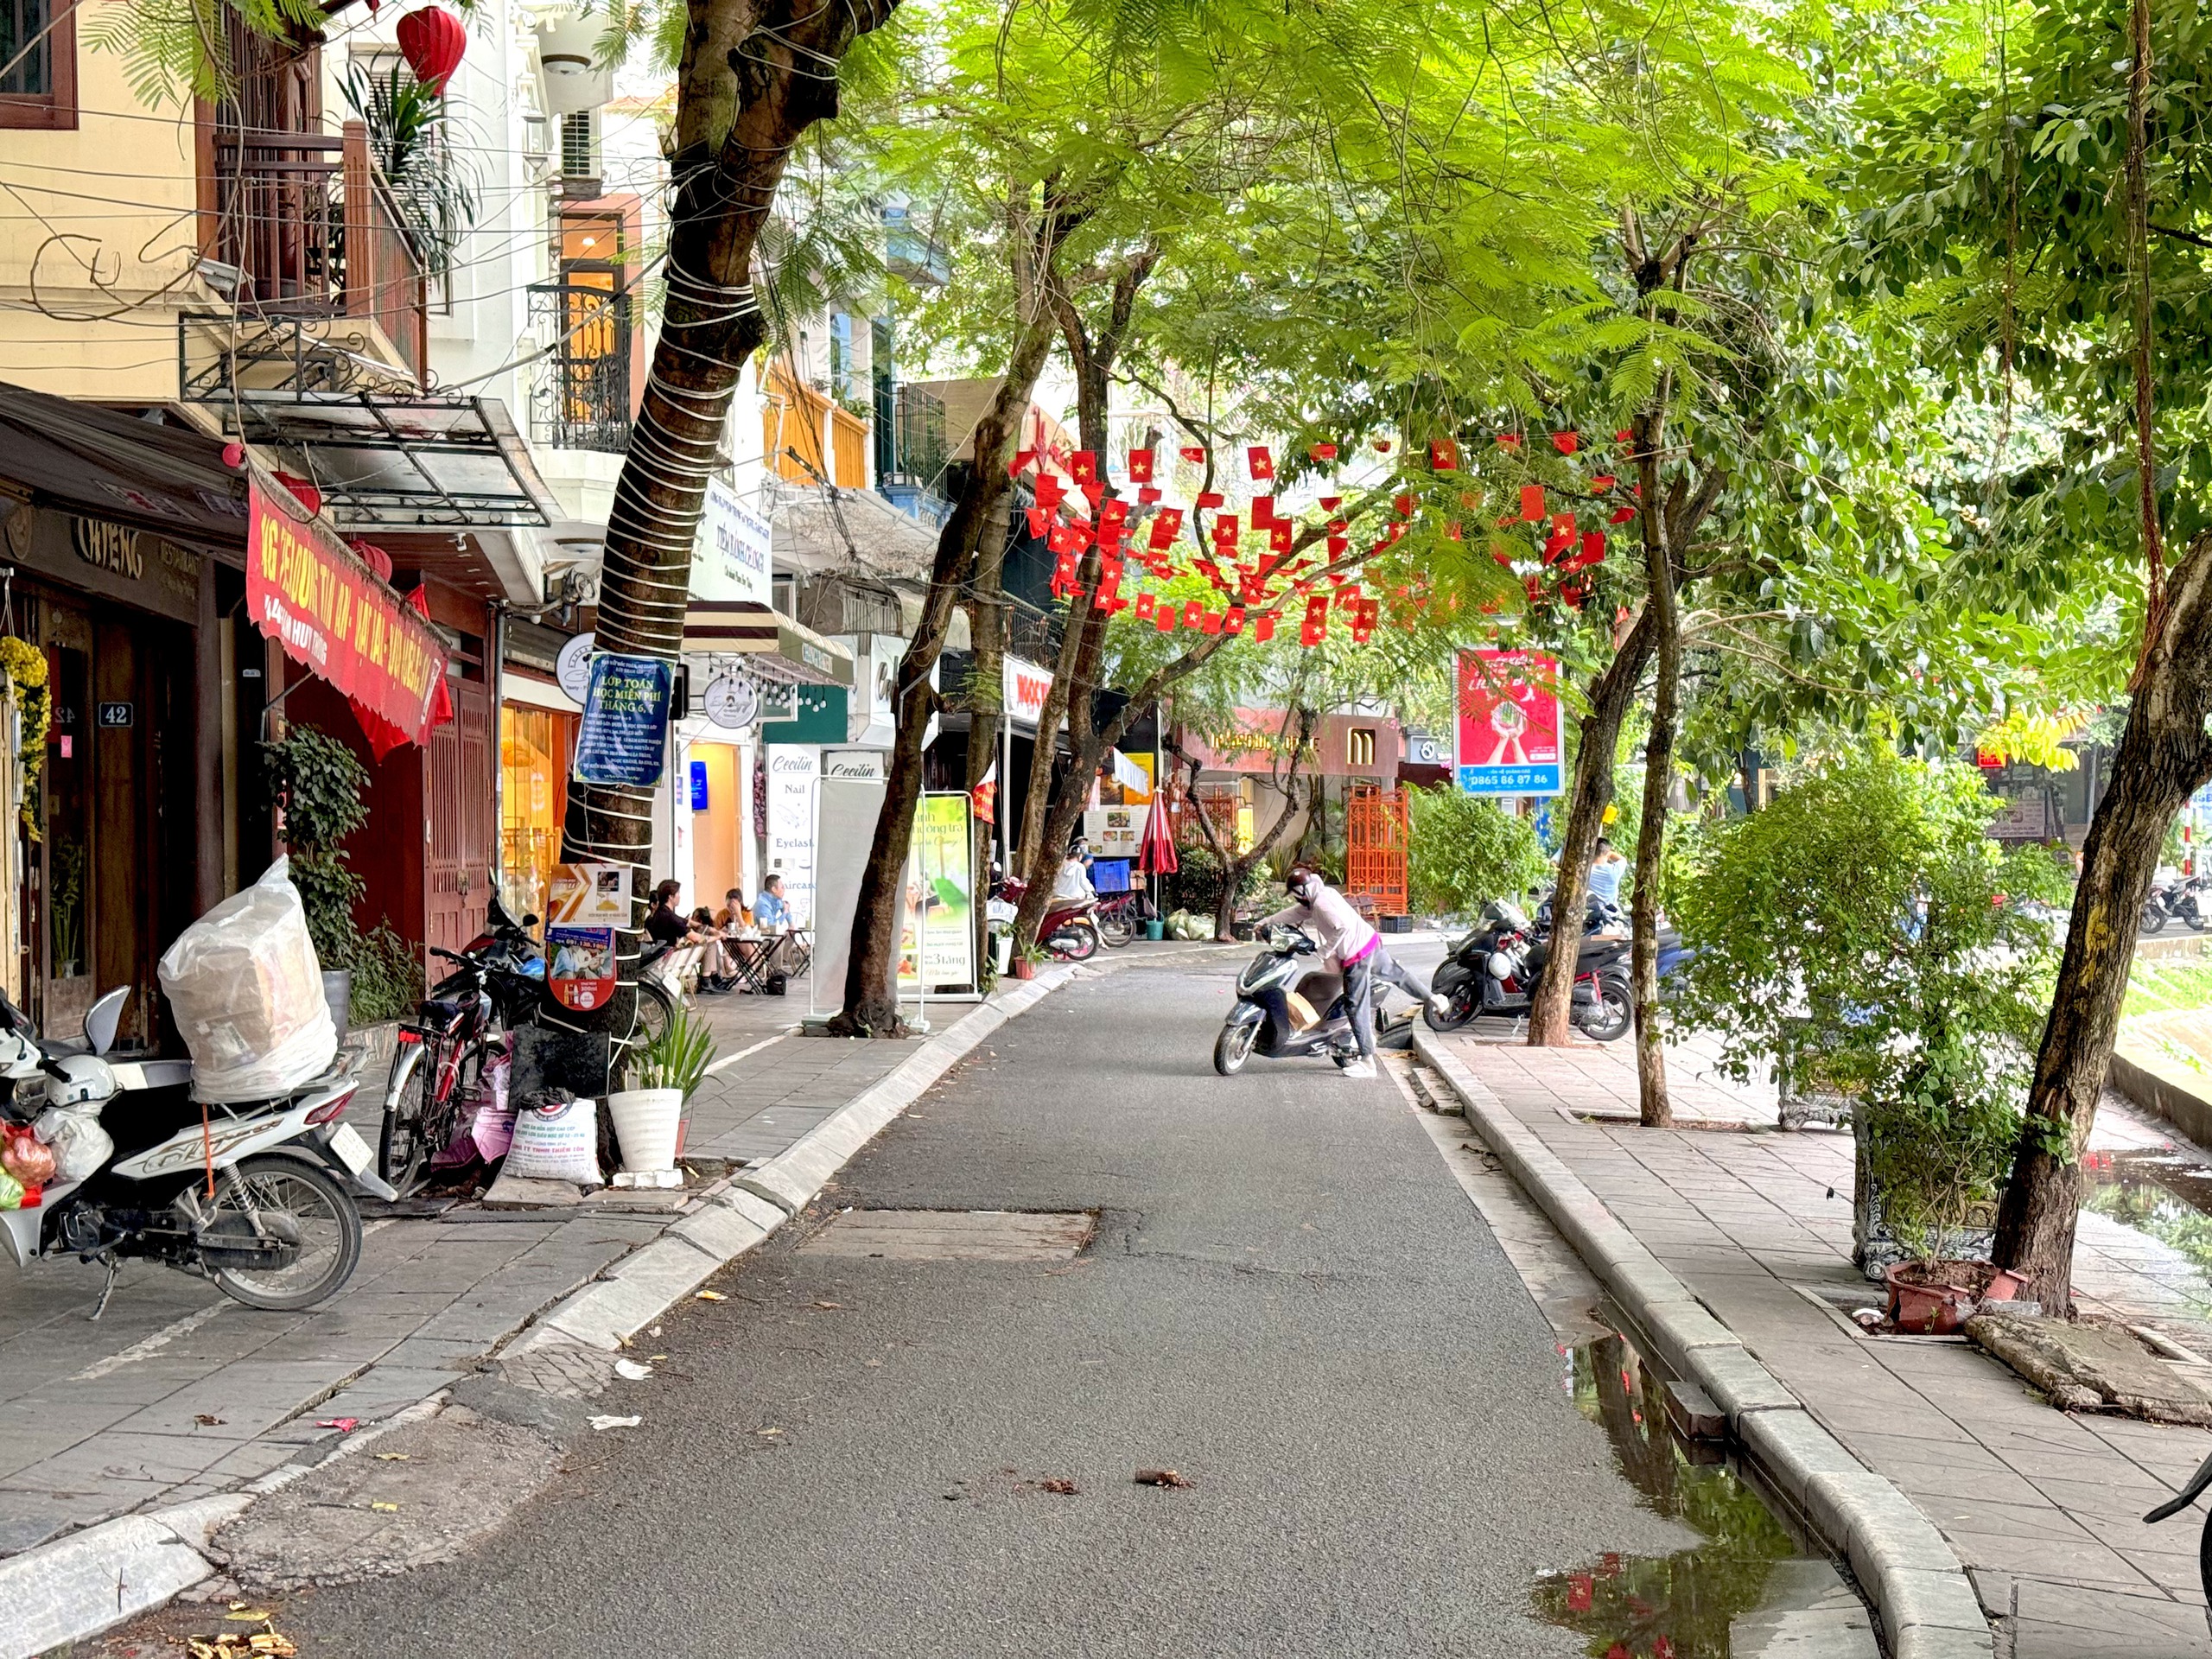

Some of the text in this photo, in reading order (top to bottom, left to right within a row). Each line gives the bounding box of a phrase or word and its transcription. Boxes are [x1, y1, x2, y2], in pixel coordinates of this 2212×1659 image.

[601, 675, 654, 690] LỚP TOÁN
[593, 687, 613, 698] HỌC
[644, 690, 661, 702] PHÍ
[599, 698, 635, 712] THÁNG
[105, 706, 126, 723] 42
[772, 755, 813, 772] Cecilin
[831, 763, 875, 778] Cecilin
[1471, 774, 1548, 785] 0865 86 87 86
[785, 784, 805, 794] Nail
